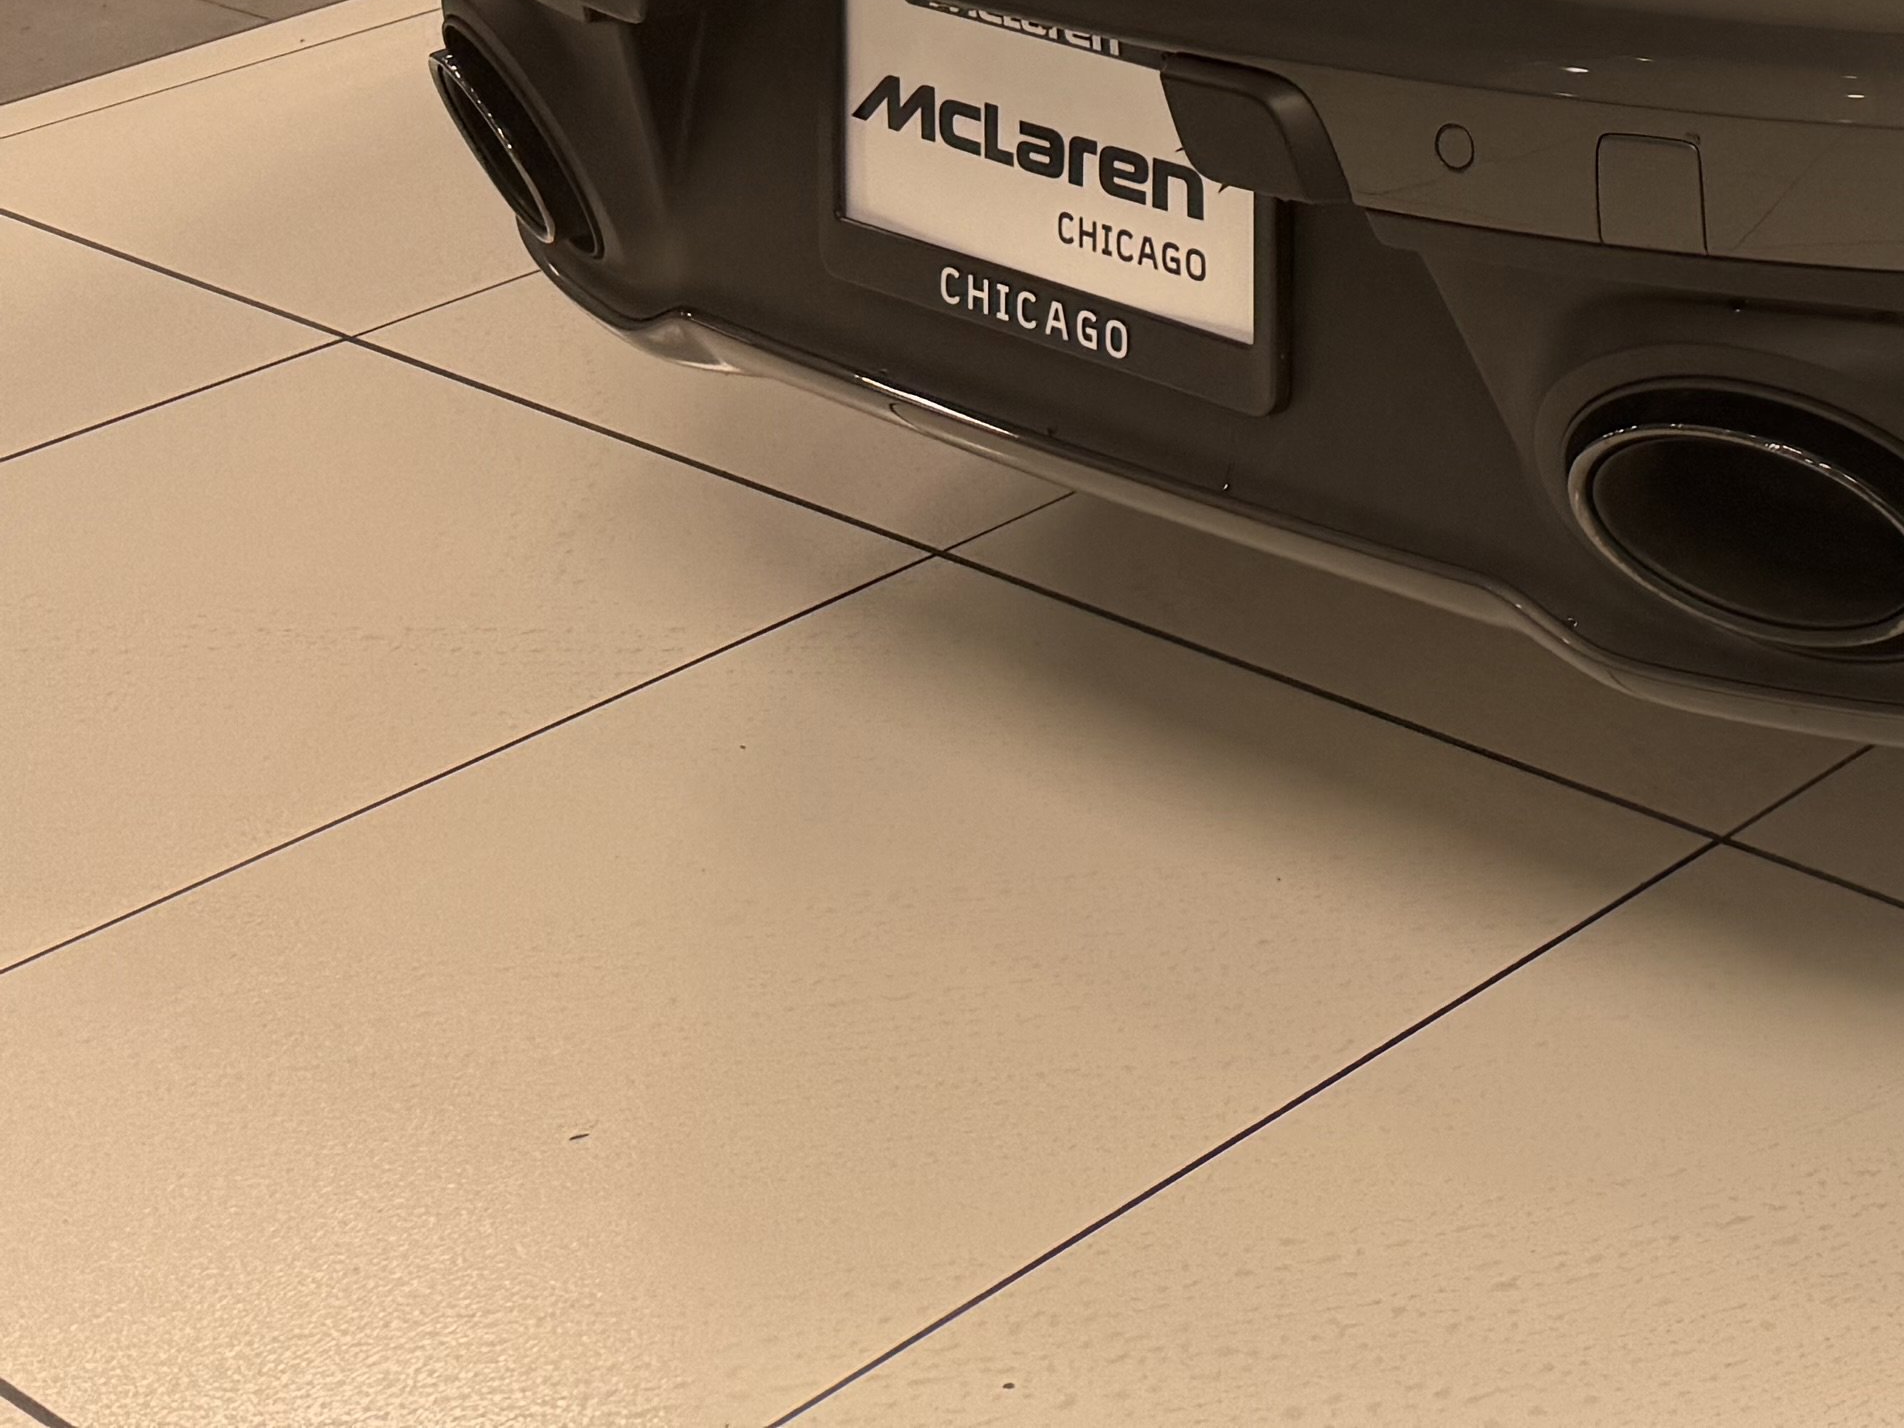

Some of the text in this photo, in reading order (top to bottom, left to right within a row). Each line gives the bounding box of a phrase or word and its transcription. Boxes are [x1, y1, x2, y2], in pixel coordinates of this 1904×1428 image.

[851, 73, 1206, 221] McLaren
[1056, 210, 1208, 283] CHICAGO
[939, 266, 1131, 361] CHICAGO
